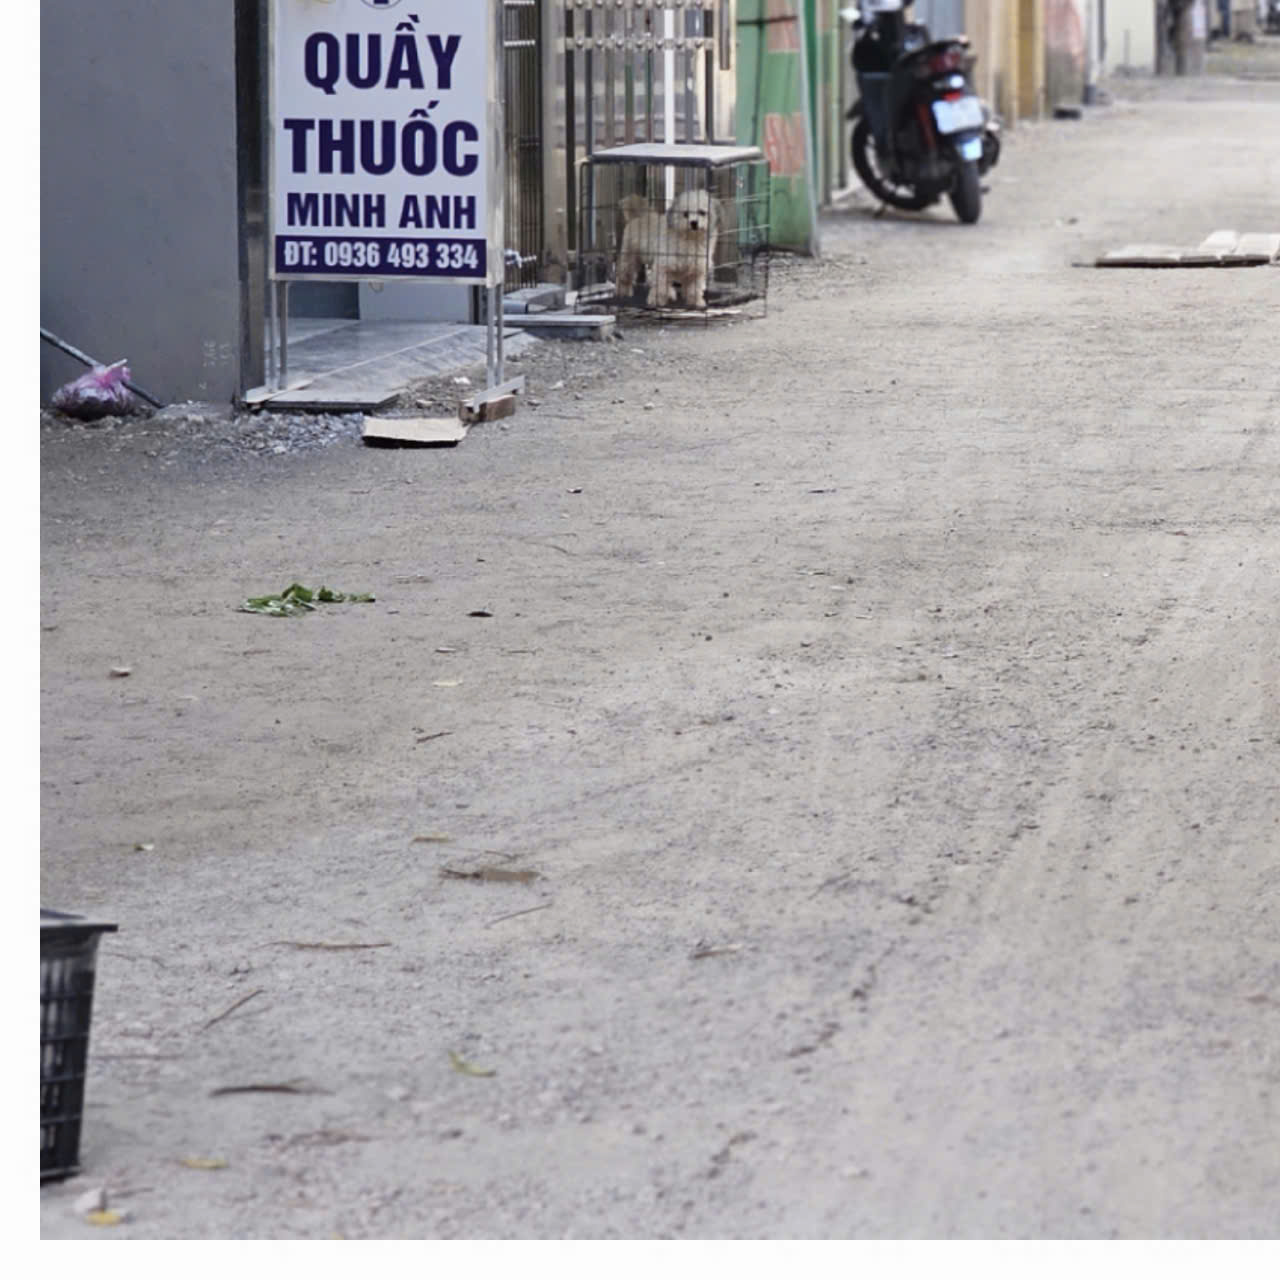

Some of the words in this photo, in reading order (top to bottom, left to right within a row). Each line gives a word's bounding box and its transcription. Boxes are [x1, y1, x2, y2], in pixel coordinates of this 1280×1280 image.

[304, 14, 462, 95] QUẦY
[283, 100, 479, 177] THUỐC
[287, 193, 386, 228] MINH
[399, 194, 476, 230] ANH
[284, 241, 317, 266] ĐT:
[324, 241, 380, 267] 0936
[387, 242, 429, 268] 493
[436, 243, 478, 269] 334
